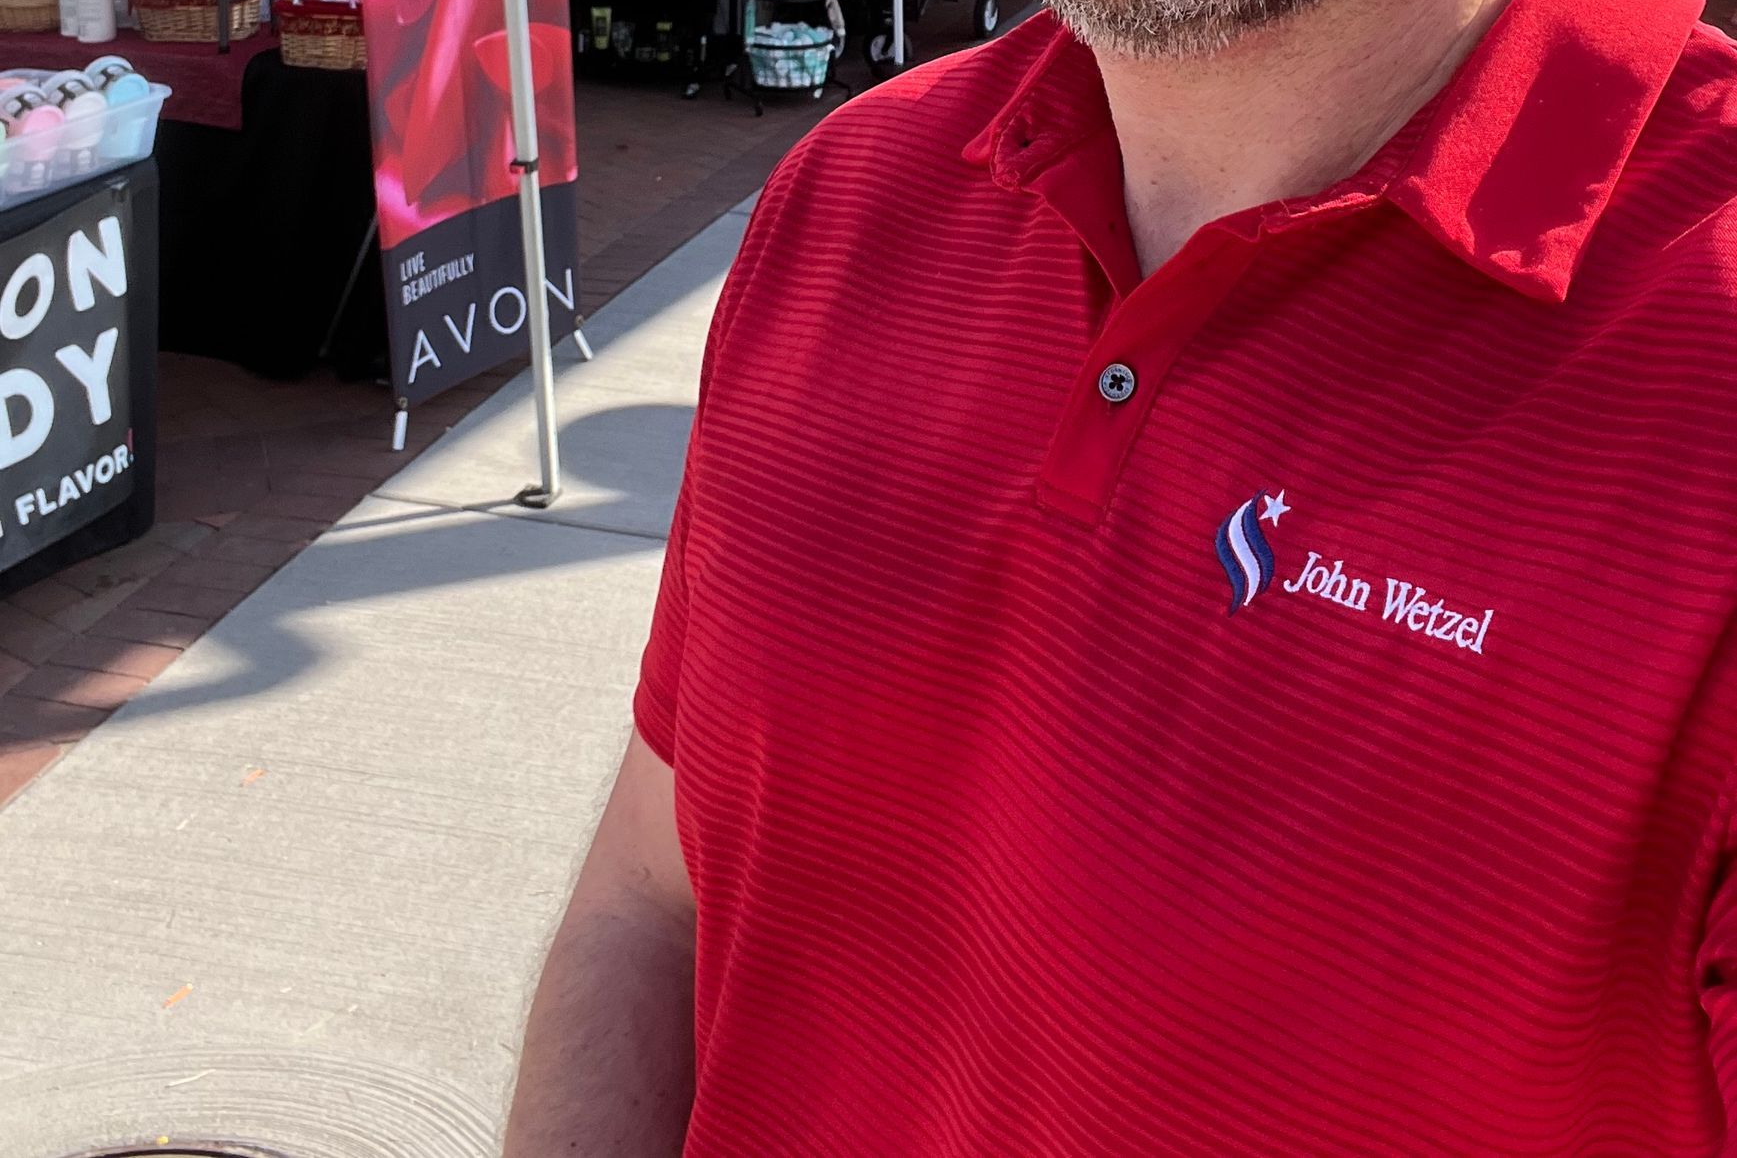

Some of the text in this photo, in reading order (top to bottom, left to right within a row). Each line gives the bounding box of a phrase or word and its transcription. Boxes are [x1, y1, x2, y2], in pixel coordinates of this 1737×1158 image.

[0, 215, 128, 340] ON
[400, 251, 426, 282] LIVE
[401, 253, 475, 307] BEAUTIFULLY
[407, 268, 575, 385] AVON
[0, 327, 119, 470] DY
[1283, 551, 1495, 655] John Wetzel
